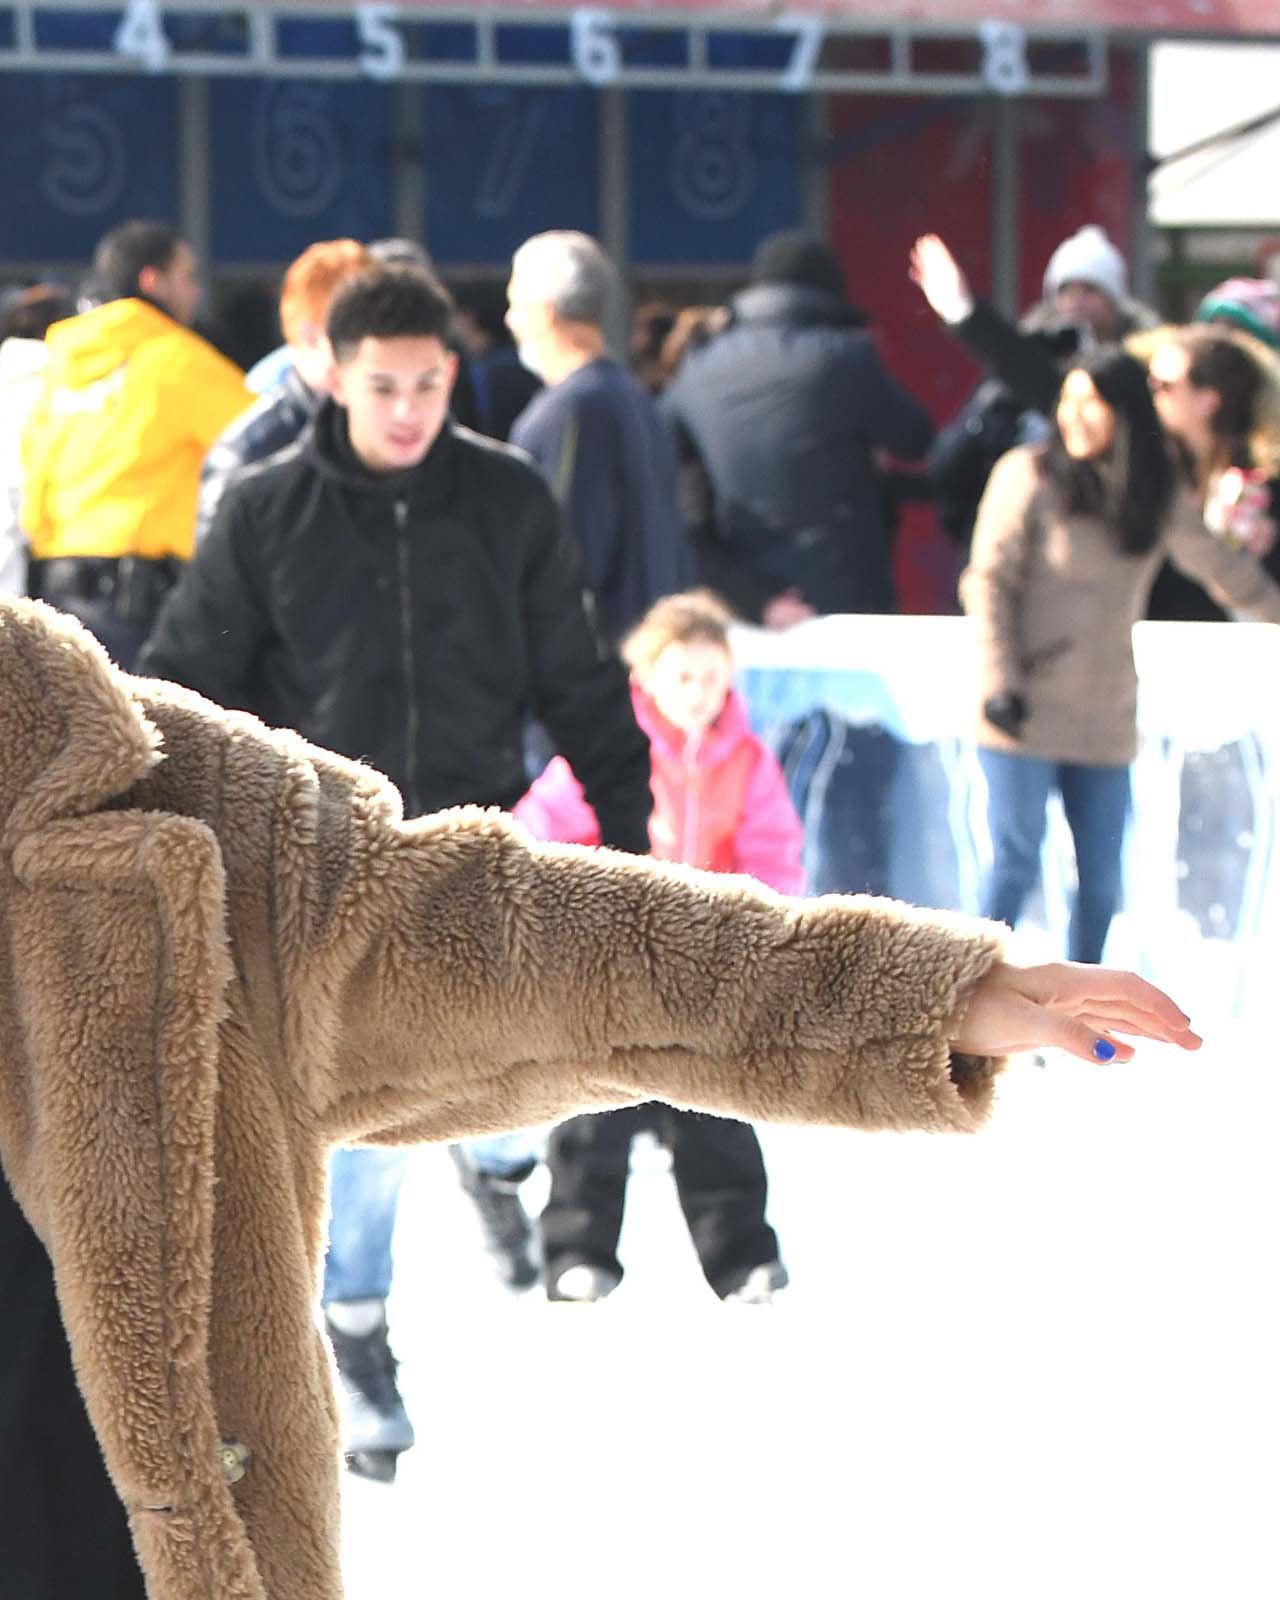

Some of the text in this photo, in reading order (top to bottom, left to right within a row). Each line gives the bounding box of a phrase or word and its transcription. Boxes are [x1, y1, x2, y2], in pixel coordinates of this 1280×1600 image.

[114, 0, 170, 74] 4
[355, 2, 407, 79] 5
[570, 9, 618, 85] 6
[776, 17, 822, 91] 7
[980, 19, 1028, 93] 8
